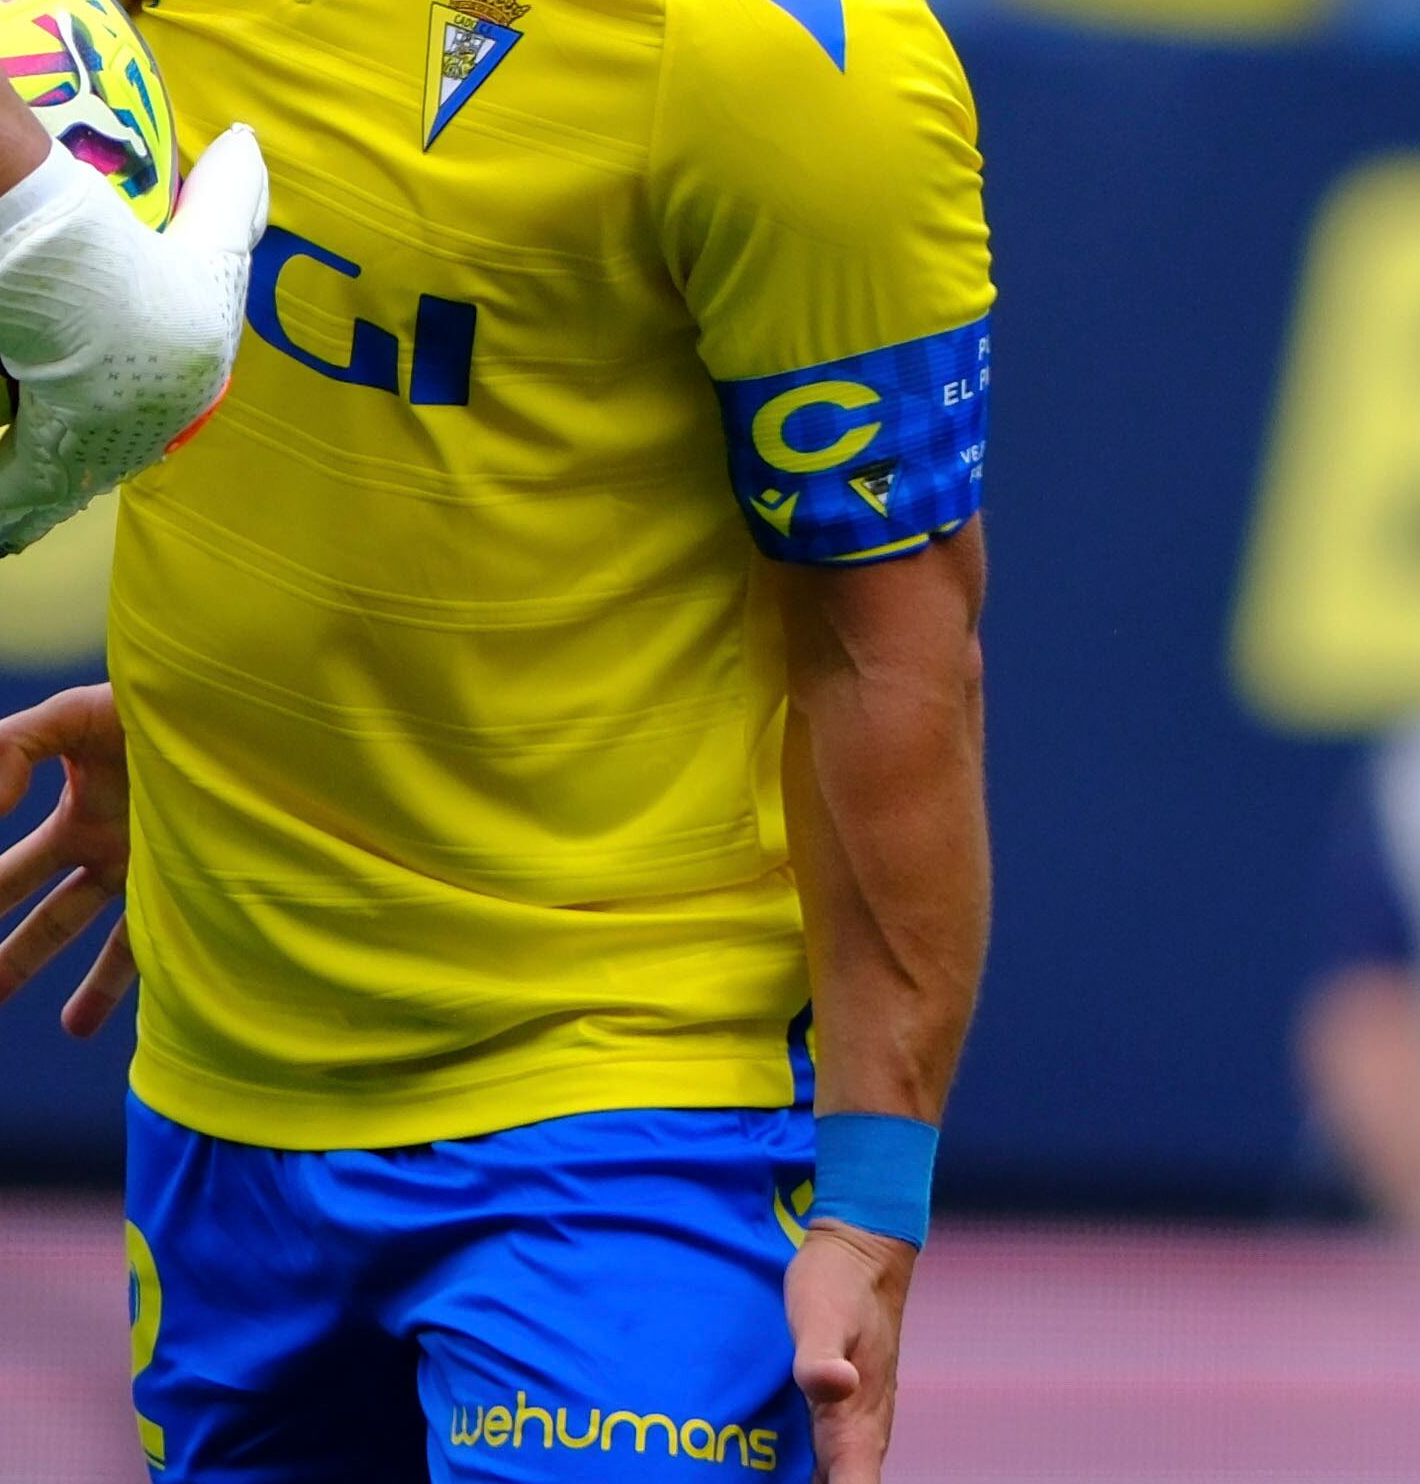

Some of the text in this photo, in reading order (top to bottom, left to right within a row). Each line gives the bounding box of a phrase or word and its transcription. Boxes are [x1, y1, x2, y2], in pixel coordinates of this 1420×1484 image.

[246, 224, 477, 406] GI
[752, 380, 882, 473] C
[450, 1390, 778, 1472] wehumans
